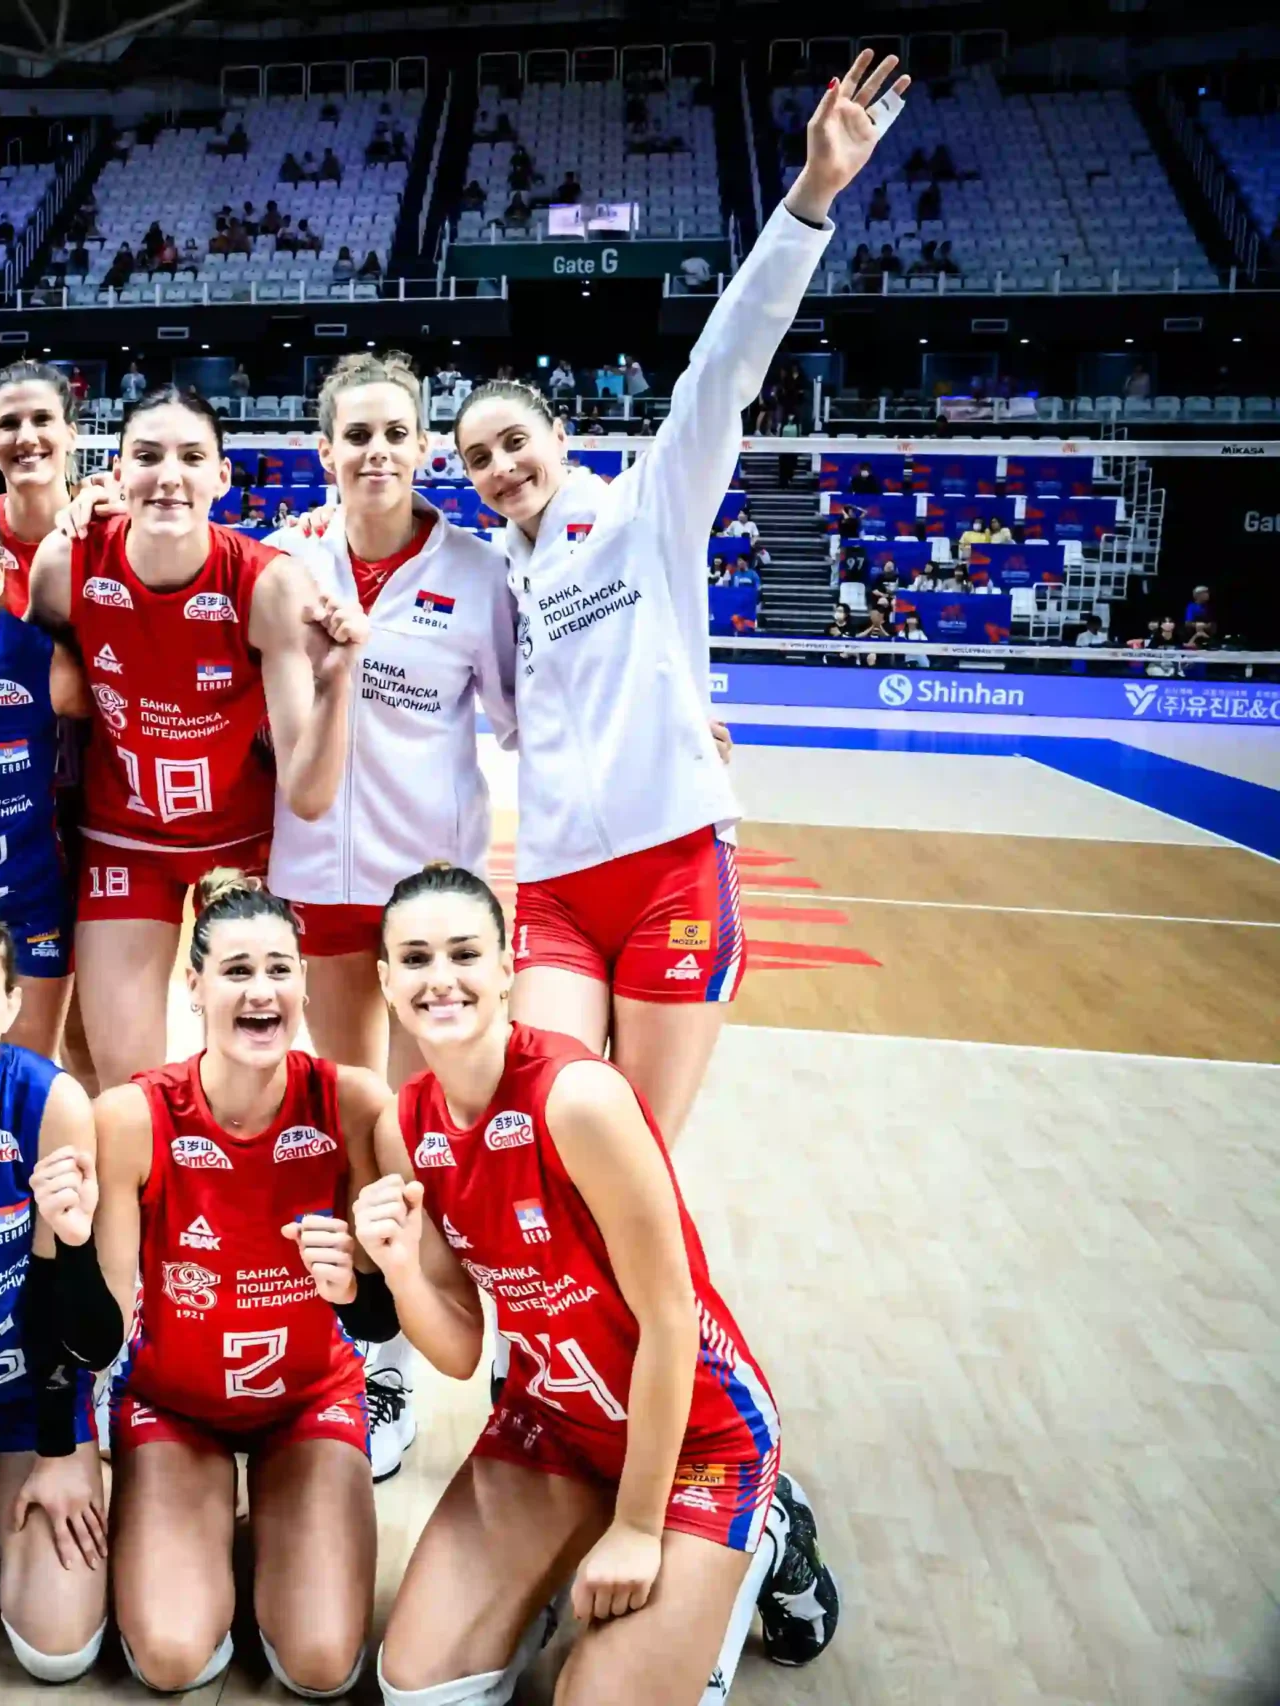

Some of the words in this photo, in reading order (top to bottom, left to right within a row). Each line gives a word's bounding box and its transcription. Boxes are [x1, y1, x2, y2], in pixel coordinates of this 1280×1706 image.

[553, 255, 596, 275] Gate
[601, 247, 619, 274] G
[846, 556, 865, 571] 97
[196, 595, 228, 606] 百岁山
[537, 583, 583, 612] БАНКА
[543, 578, 628, 627] ПОШТАНСКА
[411, 614, 449, 631] SERBIA
[548, 589, 643, 642] ШТЕДИОНИЦА
[363, 657, 407, 680] БАНКА
[362, 672, 439, 699] ПОШТАНСКА
[916, 680, 1025, 706] Shinhan
[139, 697, 182, 714] БАНКА
[361, 687, 442, 713] ШТЕДИОНИЦА
[140, 711, 223, 728] ПОШТАНСКА
[141, 719, 231, 741] ШТЕДИОНИЦА
[116, 744, 213, 824] 18
[89, 866, 130, 898] 18
[664, 967, 705, 980] PEAK
[494, 1114, 526, 1130] 百岁山
[280, 1127, 316, 1145] 百岁山
[179, 1231, 221, 1251] PEAK
[236, 1265, 290, 1281] БАНКА
[490, 1265, 541, 1282] БАНКА
[175, 1309, 205, 1321] 1921
[223, 1325, 288, 1400] 2
